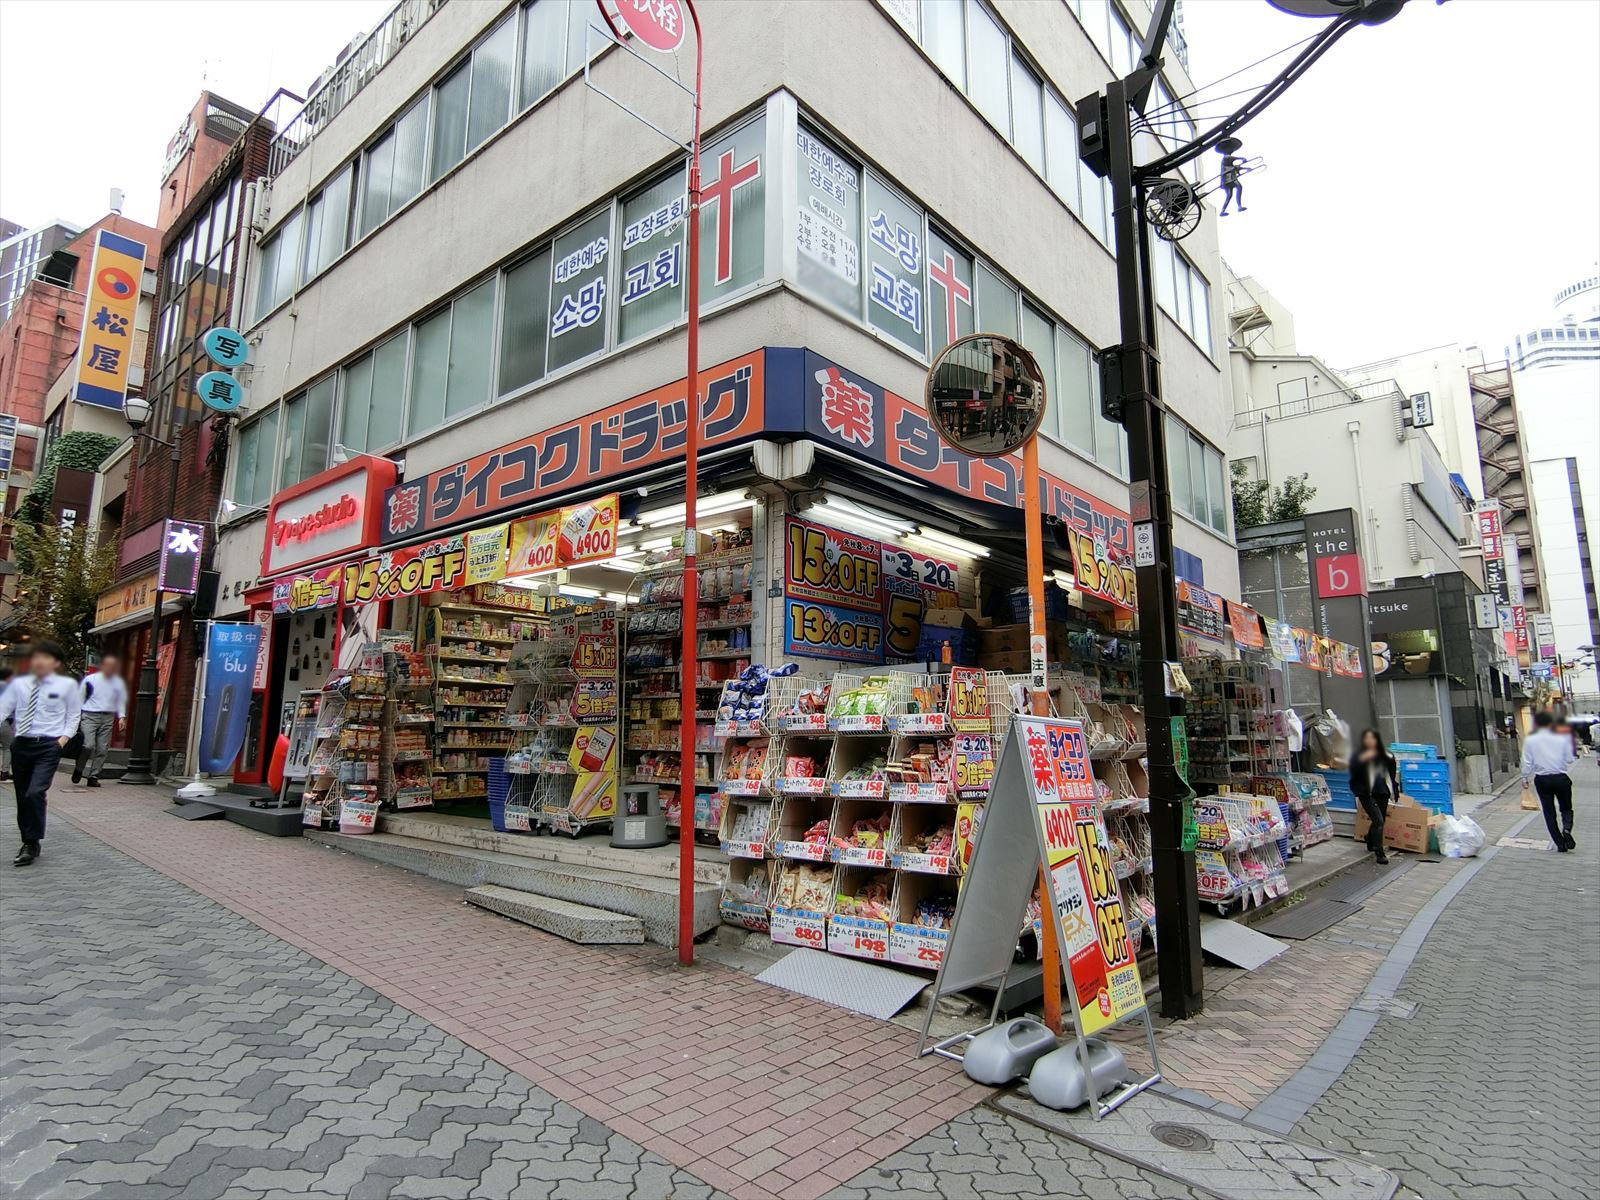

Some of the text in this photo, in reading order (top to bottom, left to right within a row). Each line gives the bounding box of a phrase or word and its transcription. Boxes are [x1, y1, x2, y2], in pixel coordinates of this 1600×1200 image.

[797, 134, 857, 190] 대한예수교
[809, 166, 846, 206] 장로회
[556, 239, 608, 279] 대한예수
[625, 196, 685, 247] 교장로회
[871, 211, 919, 272] 소망
[552, 243, 683, 336] 소망 교회
[872, 264, 920, 331] 교회
[87, 306, 129, 376] 松屋
[814, 367, 875, 448] 薬
[432, 364, 753, 522] ダイコクドラッグ
[388, 485, 420, 534] 薬
[168, 527, 200, 554] 水
[576, 529, 611, 556] 4900
[1313, 527, 1346, 537] HOTEL
[528, 543, 553, 567] 400
[789, 521, 880, 599] 15%OFF
[1137, 551, 1153, 561] 1476
[1314, 540, 1349, 554] the
[345, 547, 467, 605] 15%OFF
[1067, 525, 1138, 609] 15%OF
[790, 602, 881, 651] 13%OFF
[394, 643, 412, 653] 698
[224, 657, 247, 673] blu
[809, 714, 825, 725] 348
[864, 715, 882, 725] 398
[925, 714, 943, 725] 198
[1048, 729, 1084, 759] ダイコク
[1027, 726, 1056, 795] 薬
[1058, 760, 1086, 780] ドラッグ
[745, 780, 760, 790] 168
[808, 778, 824, 788] 248
[865, 782, 883, 792] 158
[907, 784, 918, 795] 158
[1044, 807, 1075, 849] 4900
[808, 844, 824, 855] 248
[866, 849, 884, 861] 118
[929, 855, 948, 868] 198
[1075, 821, 1118, 902] 15%
[1057, 893, 1083, 917] アリナミン
[795, 926, 823, 942] 880
[1061, 906, 1087, 943] EX
[1095, 900, 1129, 967] OFF
[854, 937, 887, 953] 198
